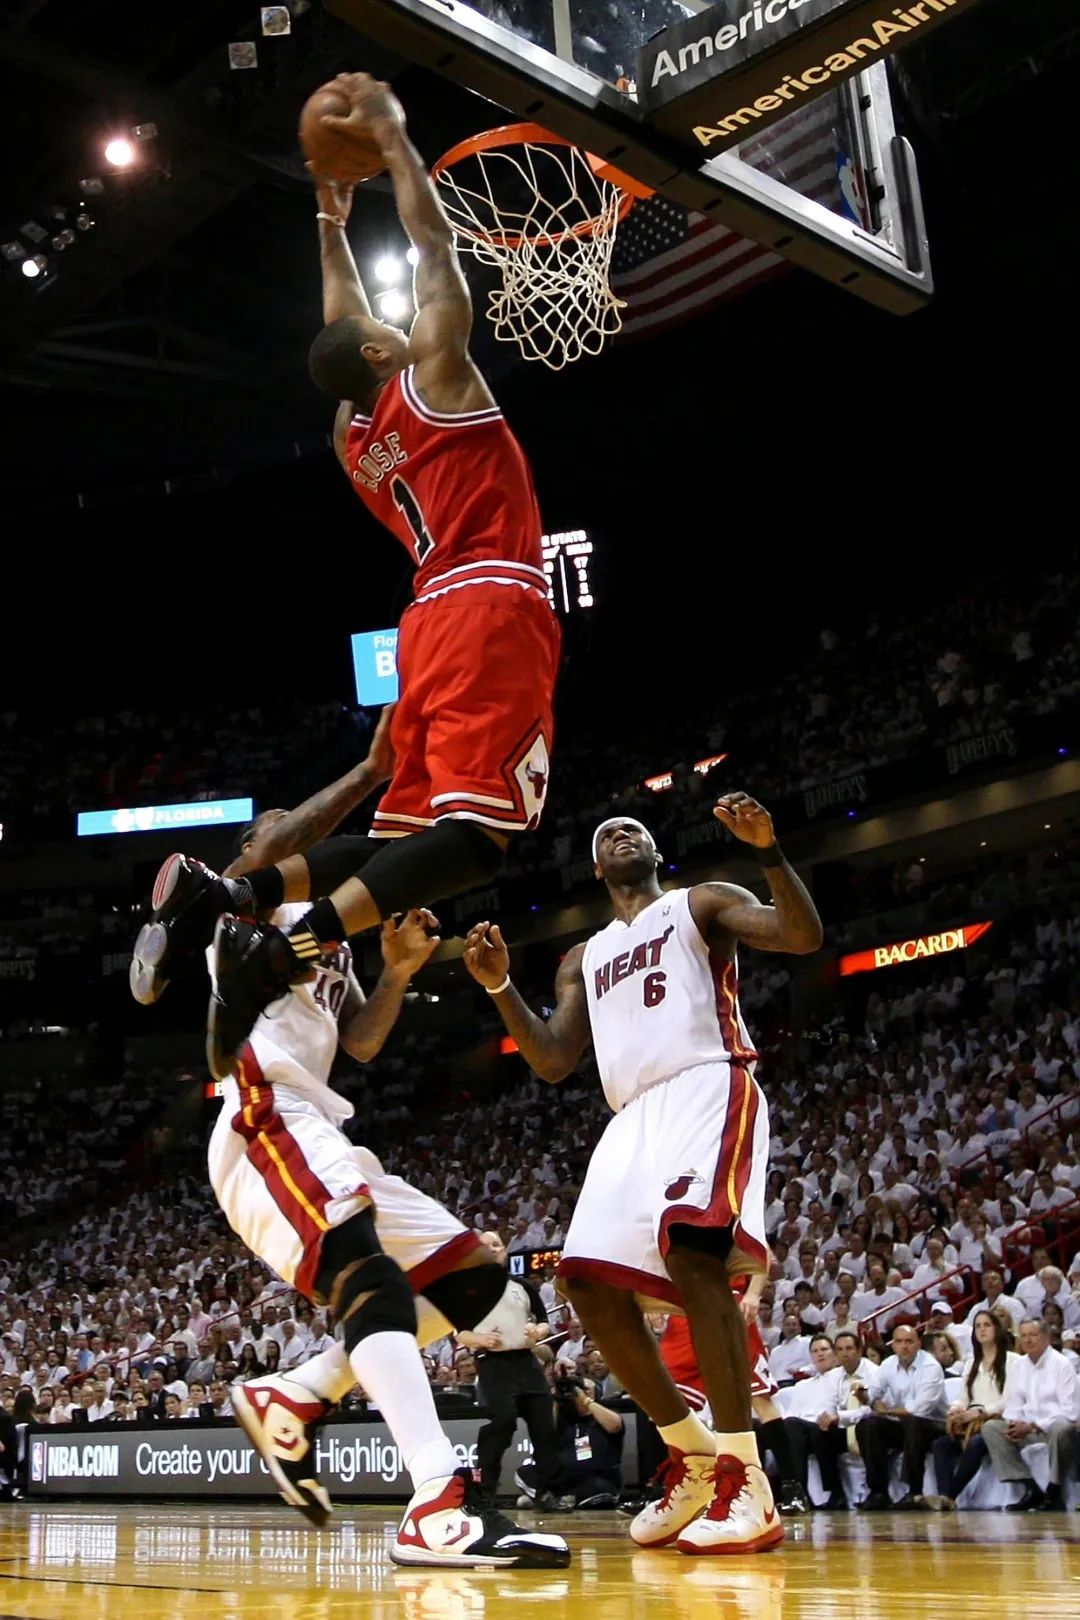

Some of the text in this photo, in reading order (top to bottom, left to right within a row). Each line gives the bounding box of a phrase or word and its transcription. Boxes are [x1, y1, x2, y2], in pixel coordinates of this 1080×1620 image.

[389, 472, 436, 567] 1
[154, 806, 225, 824] FLORIDA
[594, 924, 675, 1000] HEAT
[874, 928, 965, 967] BACARDI
[314, 973, 345, 1015] 40
[643, 971, 667, 1008] 6
[48, 1445, 119, 1477] NBA.COM
[135, 1443, 202, 1475] Create
[207, 1449, 256, 1482] your
